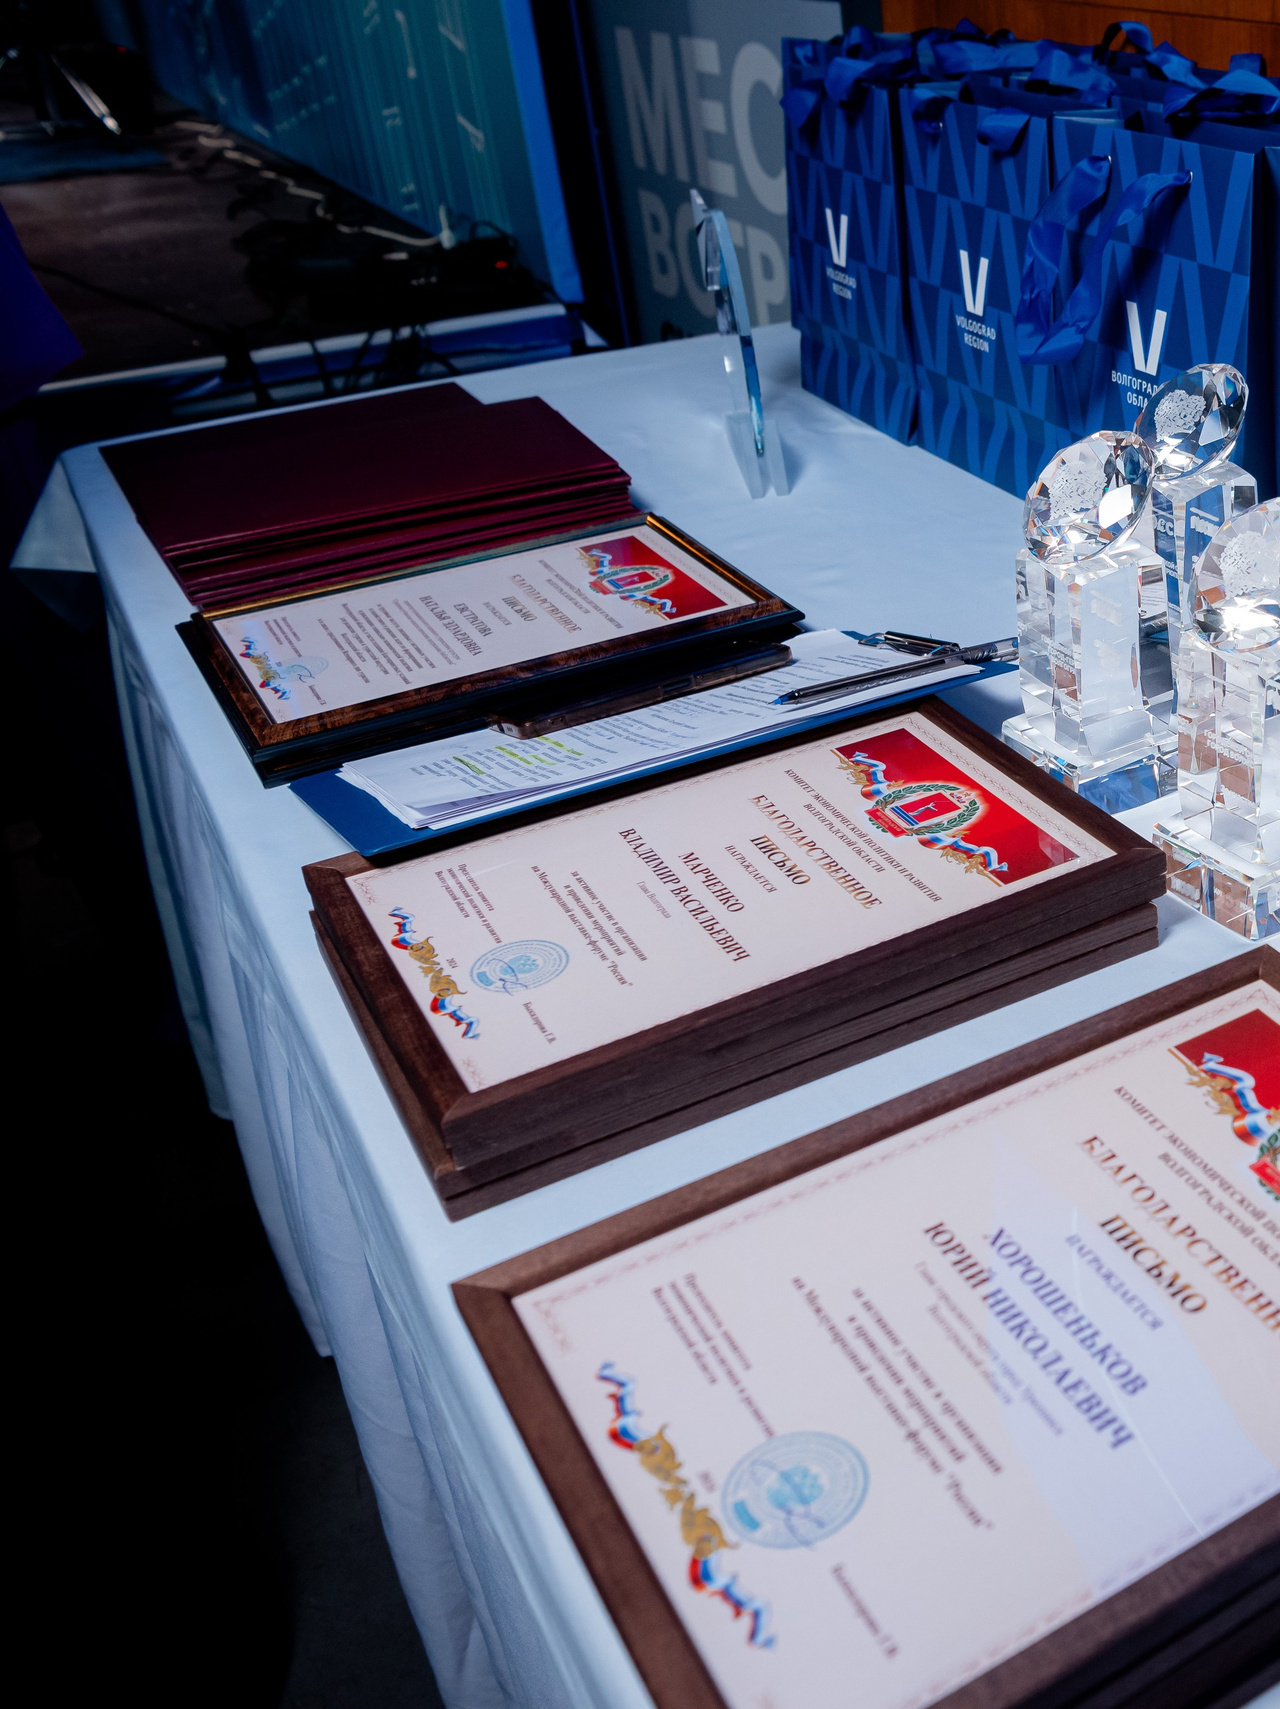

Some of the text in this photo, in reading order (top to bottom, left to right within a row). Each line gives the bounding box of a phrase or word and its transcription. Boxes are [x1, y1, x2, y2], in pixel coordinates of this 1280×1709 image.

[955, 315, 996, 341] VOLGOGRAD
[964, 332, 990, 353] REGION
[419, 596, 451, 621] НАТАЛЬЯ
[442, 620, 483, 656] ЭДУАРДОВНА
[453, 603, 493, 637] ЕВСТРАТОВА
[502, 596, 537, 621] ПИСЬМО
[511, 574, 582, 633] БЛАГОДАРСТВЕННОЕ
[750, 835, 810, 884] ПИСЬМО
[752, 795, 882, 909] БЛАГОДАРСТВЕННОЕ
[784, 769, 816, 793] КОМИТЕТ
[810, 793, 869, 839] ЭКОНОМИЧЕСКОЙ
[862, 838, 902, 869] ПОЛИТИКИ
[904, 873, 942, 902] РАЗВИТИЯ
[803, 803, 886, 872] ВОЛГОГРАДСКОЙ ОБЛАСТИ
[619, 828, 750, 961] ВЛАДИМИР ВАСИЛЬЕВИЧ
[636, 881, 650, 894] Глава
[678, 852, 744, 912] МАРЧЕНКО
[724, 845, 777, 893] НАГРАЖДАЕТСЯ
[1114, 1086, 1167, 1131] КОМИТЕТ
[1164, 1132, 1267, 1222] ЭКОНОМИЧЕСКОЙ
[1158, 1152, 1256, 1238] ВОЛГОГРАДСКОЙ
[1066, 1234, 1164, 1331] НАГРАЖДАЕТСЯ
[1099, 1215, 1206, 1313] ПИСЬМО
[924, 1222, 1134, 1449] ЮРИЙ НИКОЛАЕВИЧ
[984, 1228, 1147, 1396] ХОРОШЕНЬКОВ
